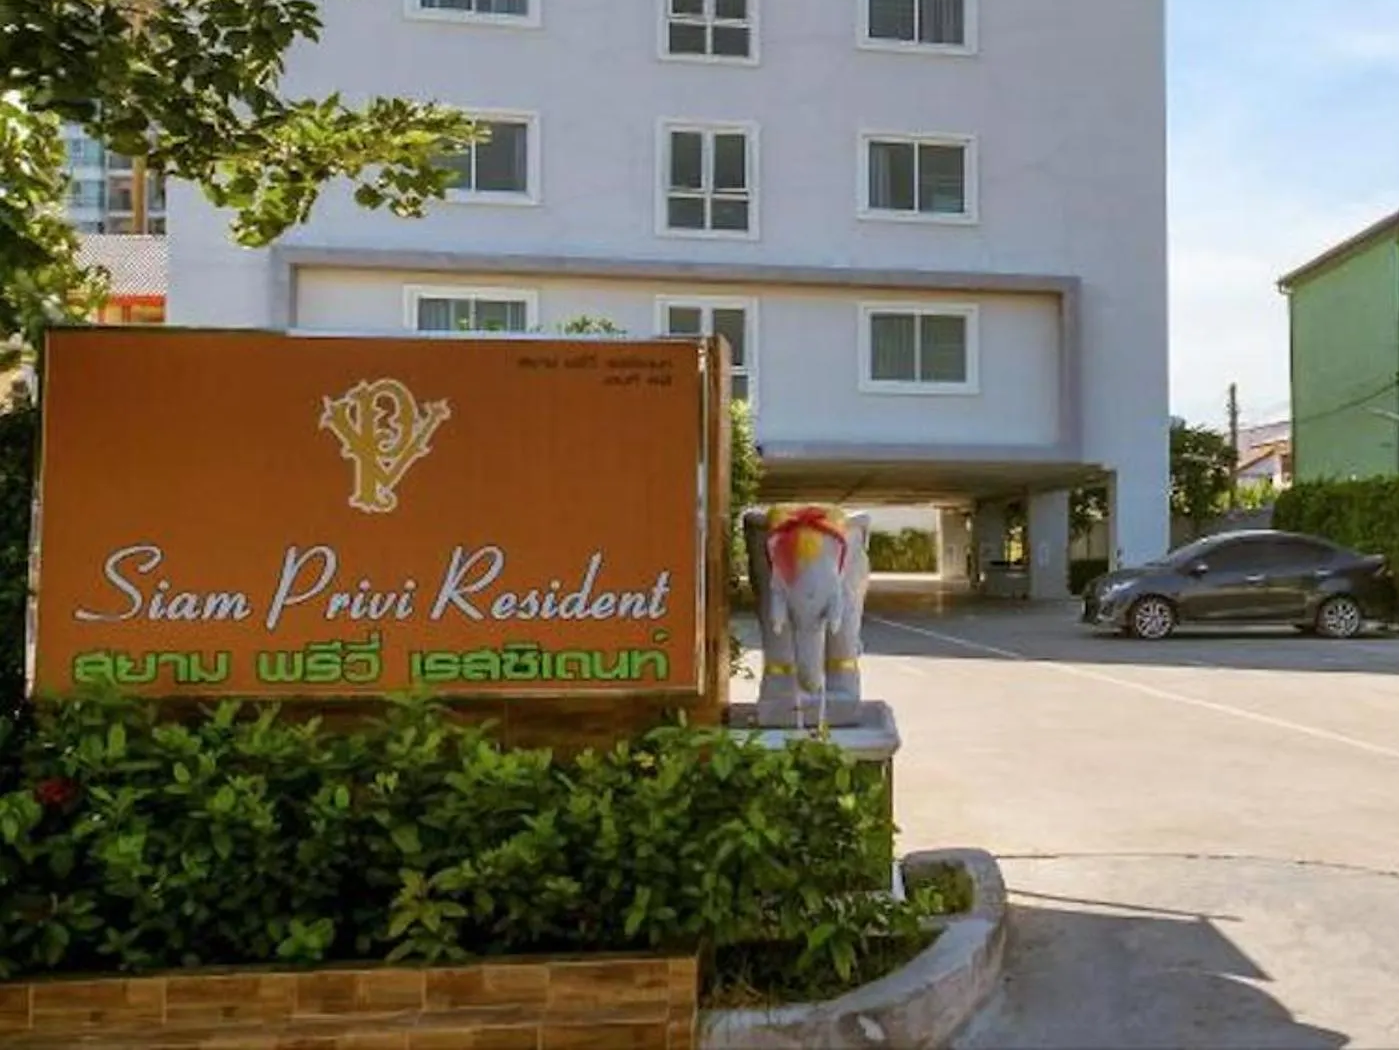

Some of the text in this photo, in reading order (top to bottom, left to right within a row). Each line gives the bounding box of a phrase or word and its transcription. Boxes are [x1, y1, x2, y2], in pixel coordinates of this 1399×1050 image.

[73, 544, 672, 631] Siam Privi Resident
[73, 648, 230, 685] สยาม
